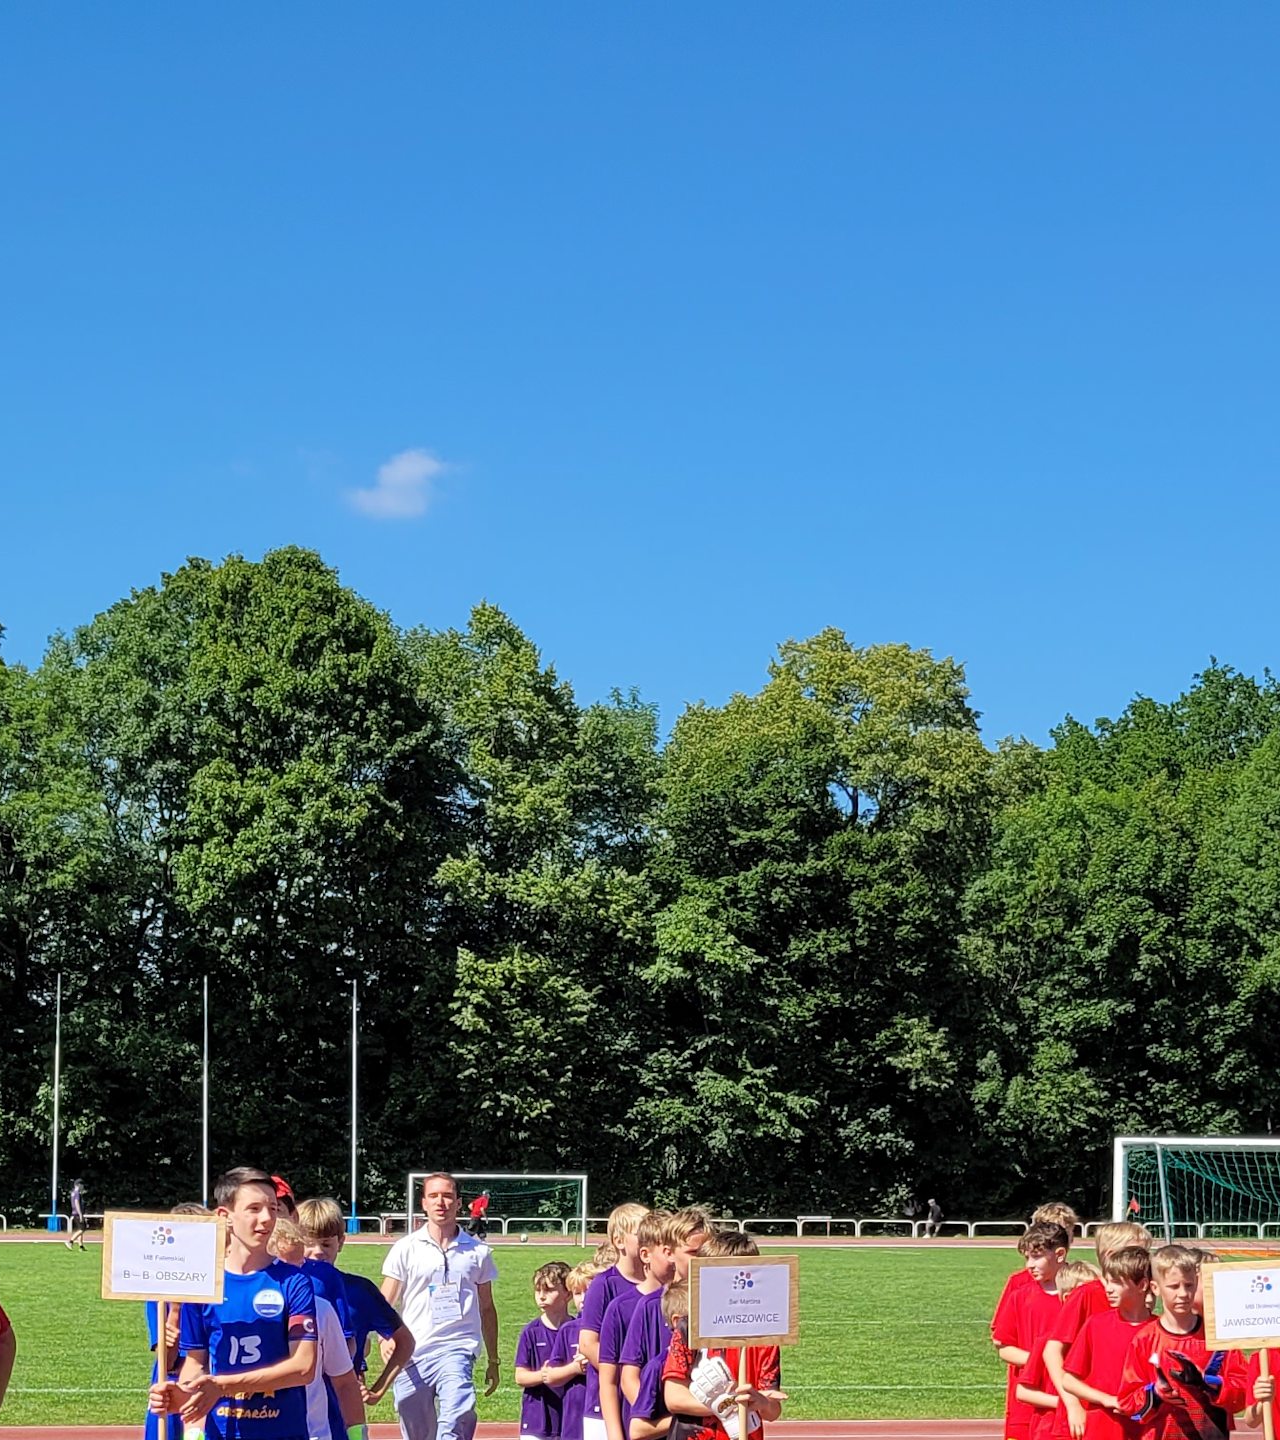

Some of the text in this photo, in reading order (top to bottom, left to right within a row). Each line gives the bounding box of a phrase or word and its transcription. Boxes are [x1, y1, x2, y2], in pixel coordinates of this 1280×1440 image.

[123, 1269, 131, 1279] B
[142, 1270, 150, 1280] B
[155, 1271, 208, 1282] OBSZARY
[712, 1313, 780, 1324] JAWISZOWICE
[303, 1318, 315, 1334] C
[229, 1335, 261, 1365] 13
